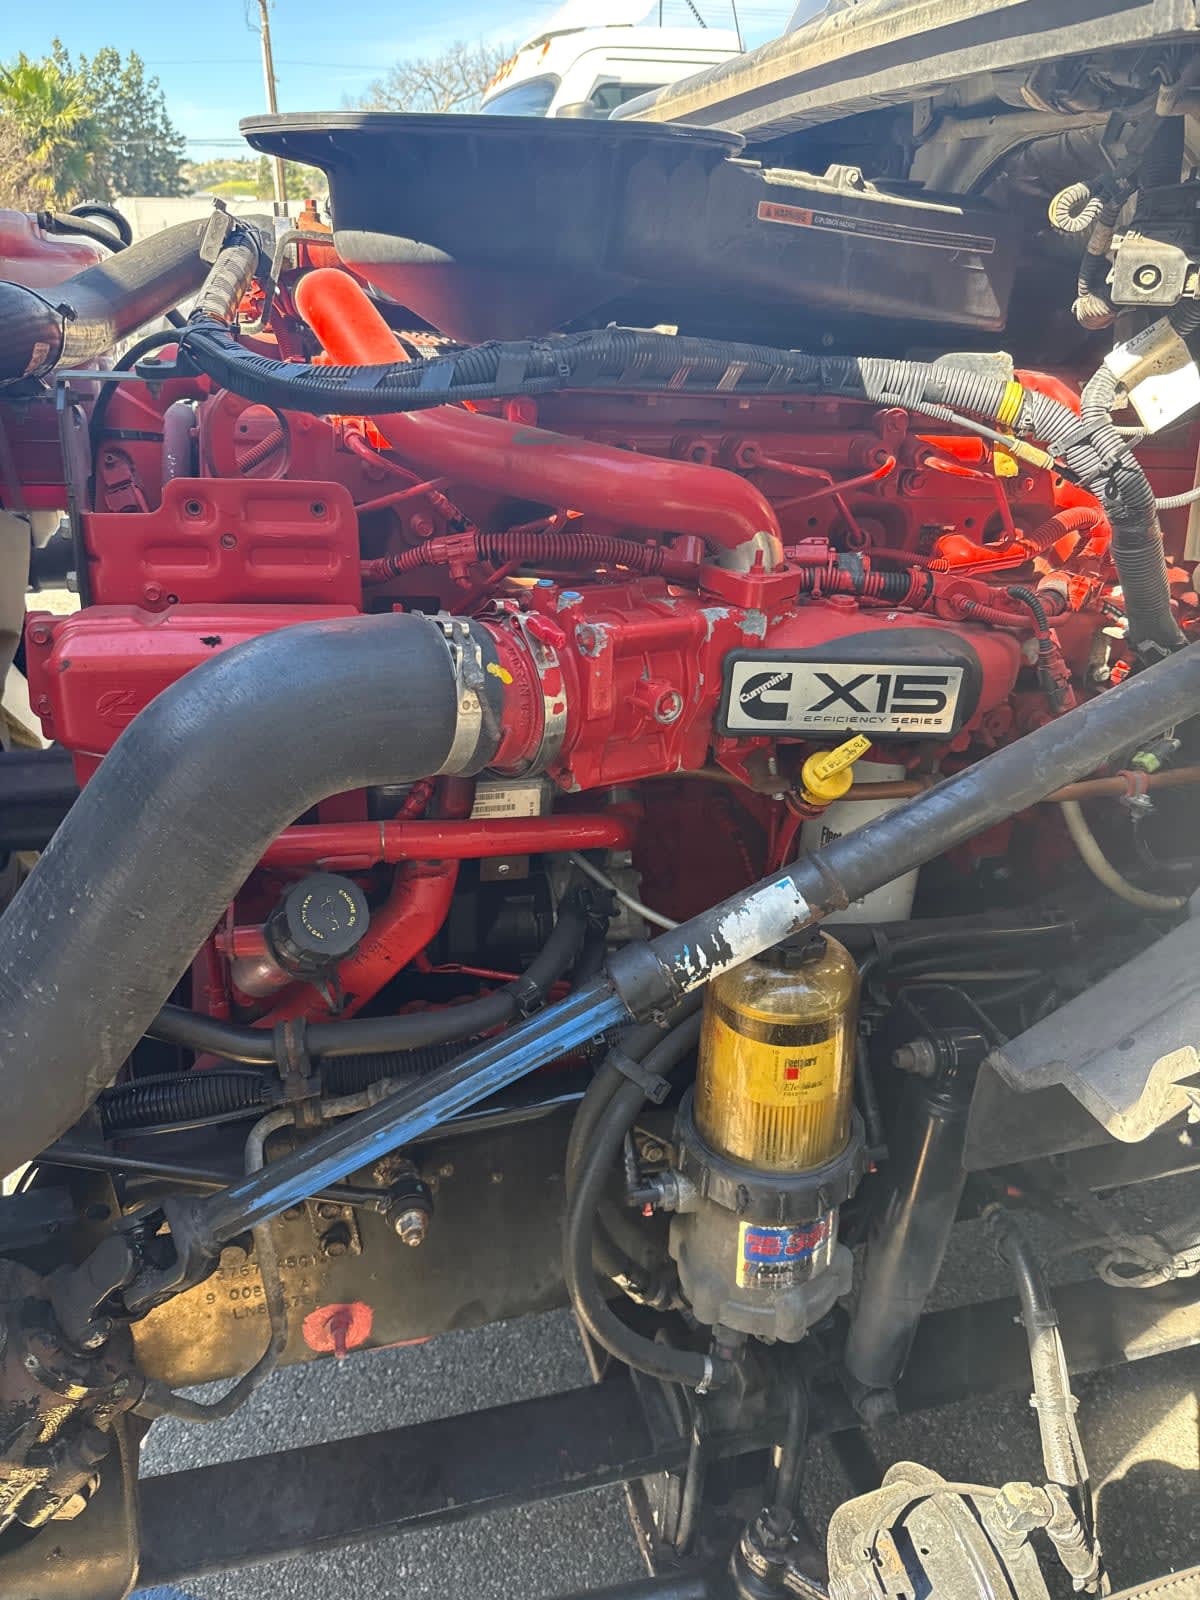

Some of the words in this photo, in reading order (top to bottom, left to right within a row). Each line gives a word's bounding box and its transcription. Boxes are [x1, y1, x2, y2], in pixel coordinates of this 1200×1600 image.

[739, 672, 789, 704] Cummins
[806, 672, 949, 714] X15
[803, 715, 887, 724] EFFICIENCY
[891, 717, 943, 725] SERIES
[338, 889, 357, 914] ENGINE
